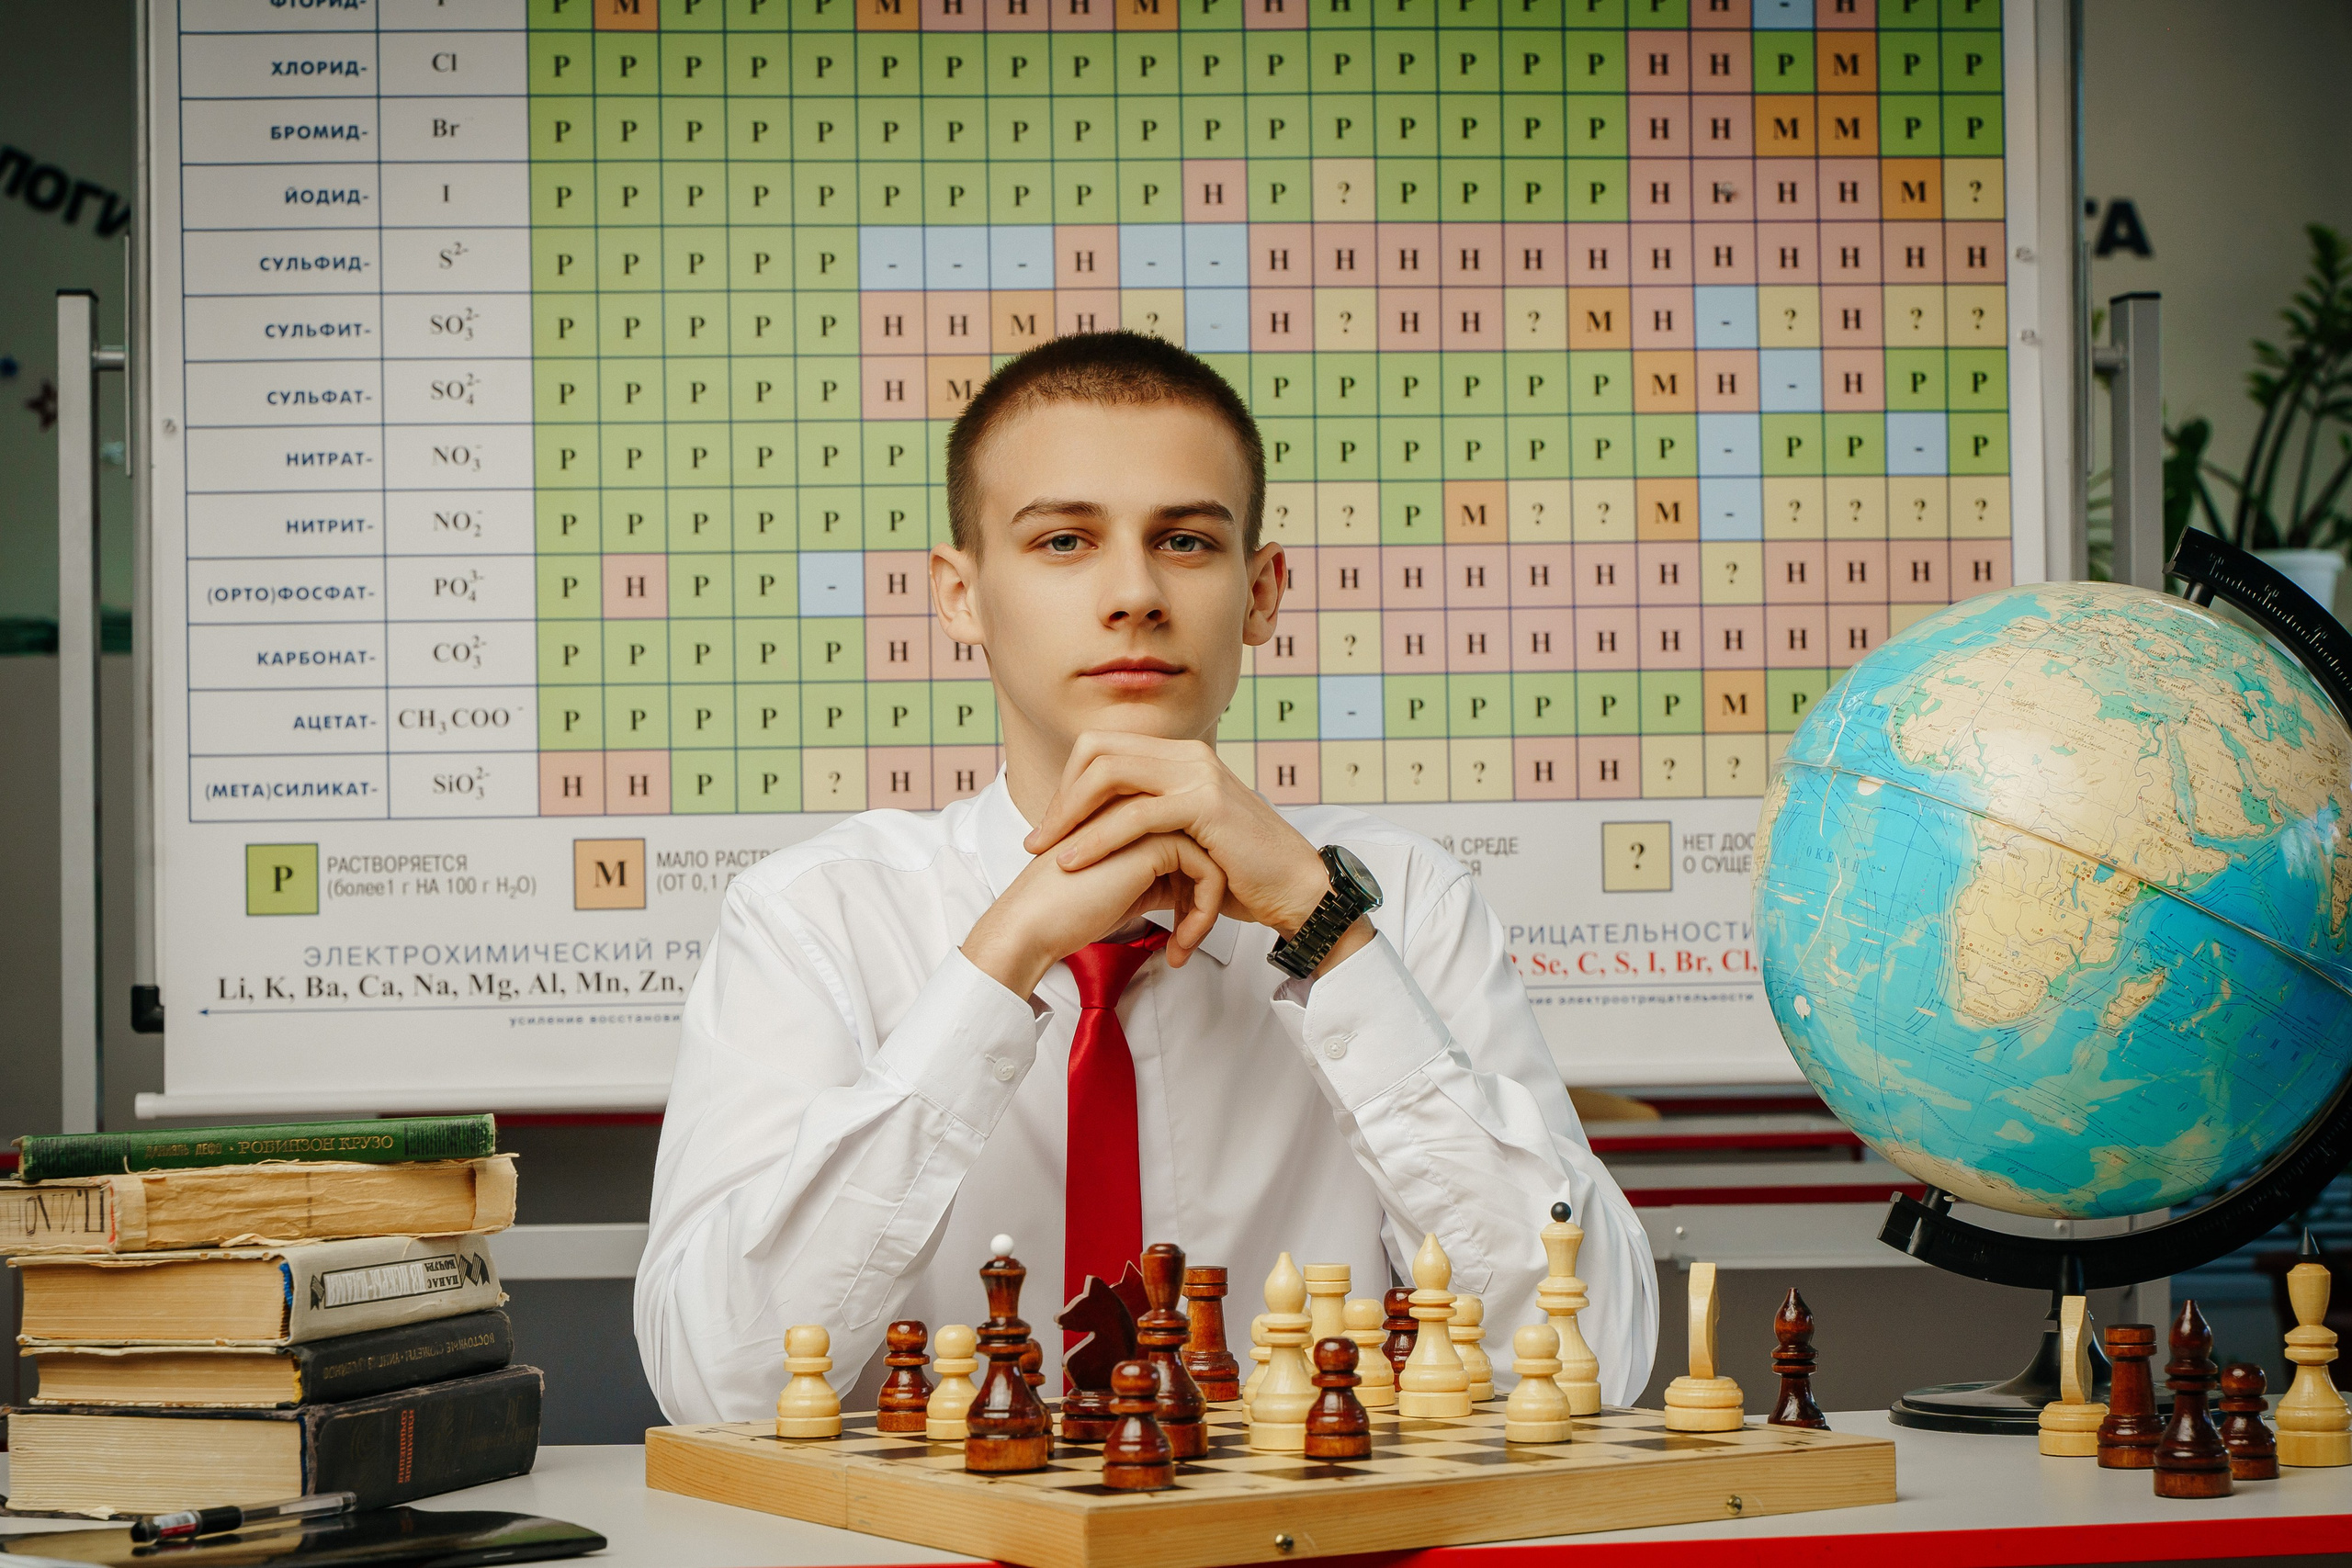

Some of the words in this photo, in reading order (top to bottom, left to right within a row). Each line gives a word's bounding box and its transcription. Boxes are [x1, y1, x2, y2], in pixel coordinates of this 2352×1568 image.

[271, 60, 368, 77] ХЛОРИД-
[553, 54, 571, 78] Р
[620, 55, 638, 78] Р
[685, 56, 703, 78] Р
[751, 56, 768, 79] Р
[816, 56, 833, 79] Р
[882, 56, 899, 78] Р
[946, 56, 963, 79] Р
[1012, 56, 1028, 78] Р
[1073, 55, 1091, 78] Р
[1140, 55, 1157, 77] Р
[1203, 54, 1220, 77] Р
[1268, 53, 1284, 76] Р
[1334, 53, 1351, 75] Р
[1398, 52, 1416, 75] Р
[1460, 52, 1477, 75] Р
[1523, 52, 1541, 75] Р
[1588, 52, 1605, 76] Р
[1648, 52, 1669, 76] Н
[1710, 52, 1731, 76] Н
[1777, 52, 1795, 76] Р
[1833, 52, 1859, 76] М
[1904, 52, 1921, 76] Р
[1965, 52, 1984, 76] Р
[270, 124, 368, 141] БРОМИД-
[284, 186, 368, 206] ЙОДИД-
[259, 255, 369, 272] СУЛЬФИД-
[264, 322, 370, 339] СУЛЬФИТ-
[266, 389, 371, 406] СУЛЬФАТ-
[286, 451, 372, 467] НИТРАТ-
[286, 518, 373, 534] НИТРИТ-
[562, 577, 578, 598] Р
[627, 576, 645, 597] Н
[695, 576, 709, 597] Р
[760, 575, 775, 596] Р
[888, 573, 907, 594] Н
[1340, 568, 1359, 589] Н
[1404, 567, 1422, 588] Н
[1466, 567, 1485, 587] Н
[1531, 565, 1549, 586] Н
[1596, 564, 1614, 585] Н
[1660, 563, 1679, 584] Н
[1725, 562, 1738, 584] ?
[1787, 562, 1805, 583] Н
[1848, 561, 1866, 583] Н
[1912, 560, 1930, 582] Н
[1973, 560, 1992, 581] Н
[207, 585, 374, 604] (ОРТО)ФОСФАТ-
[256, 650, 375, 666] КАРБОНАТ-
[565, 710, 580, 732] Р
[631, 709, 647, 731] Р
[696, 708, 712, 730] Р
[762, 708, 777, 729] Р
[827, 707, 842, 728] Р
[893, 706, 908, 728] Р
[958, 705, 973, 727] Р
[1279, 701, 1294, 722] Р
[1409, 699, 1424, 720] Р
[1472, 697, 1487, 718] Р
[1536, 696, 1551, 717] Р
[1601, 695, 1617, 716] Р
[1665, 694, 1680, 716] Р
[1724, 694, 1747, 715] М
[1792, 693, 1807, 715] Р
[292, 715, 377, 732] АЦЕТАТ-
[205, 782, 378, 801] (МЕТА)СИЛИКАТ-
[1461, 836, 1521, 857] СРЕДЕ
[1682, 832, 1714, 852] НЕТ
[327, 854, 468, 874] РАСТВОРЯЕТСЯ
[656, 850, 708, 868] МАЛО
[715, 848, 780, 868] РАСТВ
[1630, 842, 1645, 870] ?
[272, 865, 294, 893] Р
[595, 860, 626, 887] М
[416, 878, 439, 894] НА
[447, 876, 477, 895] 100
[656, 873, 686, 895] (ОТ
[303, 939, 652, 968] ЭЛЕКТРОХИМИЧЕСКИЙ
[1532, 954, 1568, 976] Se,
[1577, 953, 1606, 975] C,
[1614, 953, 1638, 975] S,
[1648, 951, 1666, 974] I,
[1676, 951, 1713, 973] Br,
[1721, 949, 1758, 973] Cl,
[219, 977, 254, 1000] Li,
[266, 976, 295, 999] K,
[307, 976, 348, 998] Ba,
[357, 976, 403, 998] Ca,
[414, 974, 458, 997] Na,
[469, 973, 520, 999] Mg,
[528, 972, 566, 995] Al,
[578, 971, 629, 993] Mn,
[639, 970, 684, 992] Zn,
[509, 1014, 584, 1028] усиление
[238, 1137, 334, 1156] РОБИНЗОН
[338, 1134, 394, 1150] КРУЗО
[426, 1274, 458, 1289] ПАНАС
[446, 1332, 496, 1354] ВОСТОЧНЫЕ
